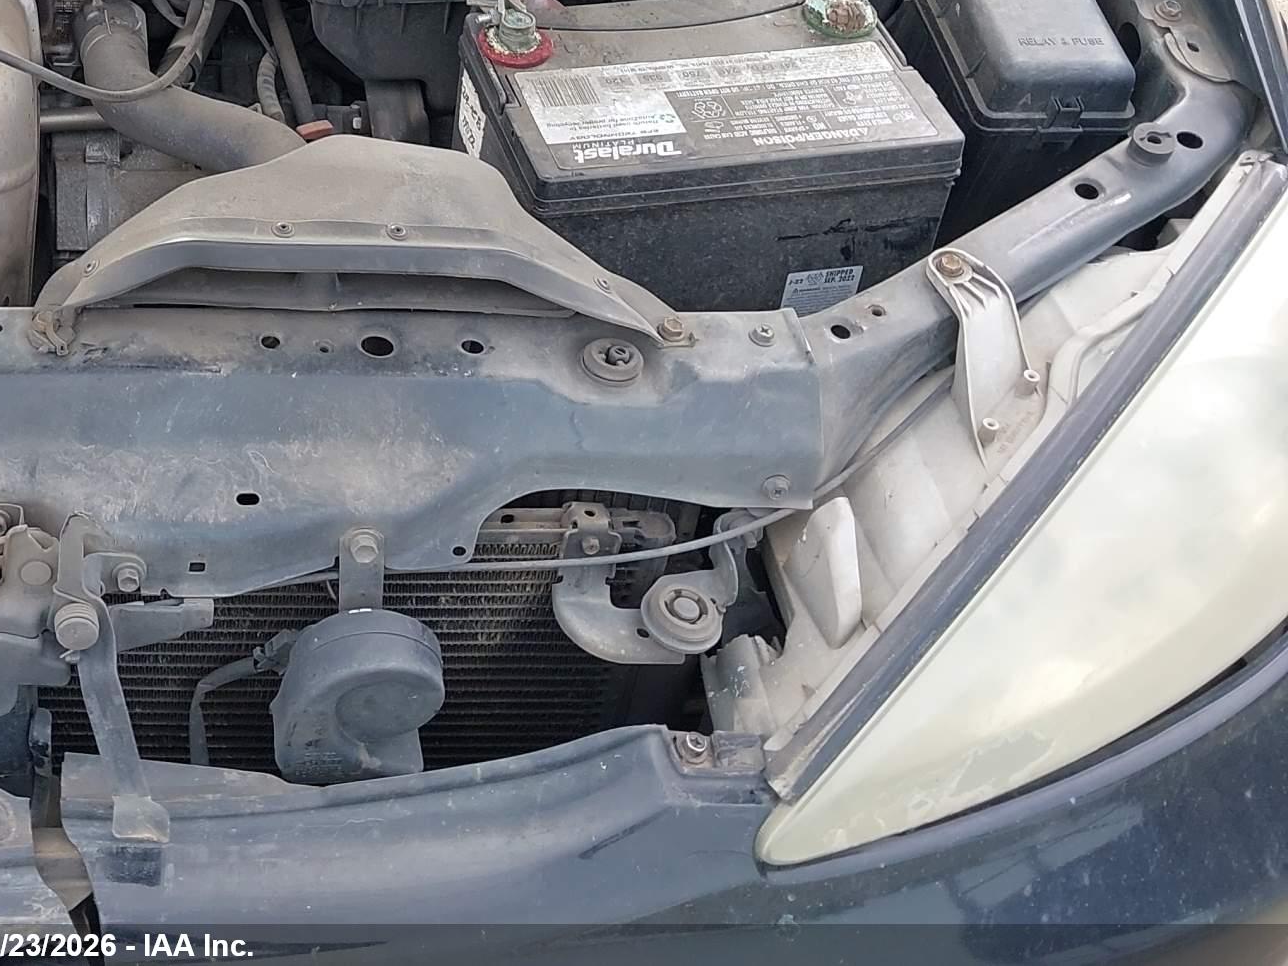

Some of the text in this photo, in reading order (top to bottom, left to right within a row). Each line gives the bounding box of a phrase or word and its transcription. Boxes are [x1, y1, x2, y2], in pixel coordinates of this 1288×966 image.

[1018, 37, 1057, 46] RELAY
[1071, 37, 1104, 46] FUSE
[571, 138, 635, 150] PLATINUM
[573, 140, 682, 164] Duralast
[825, 268, 854, 278] SHIPPED
